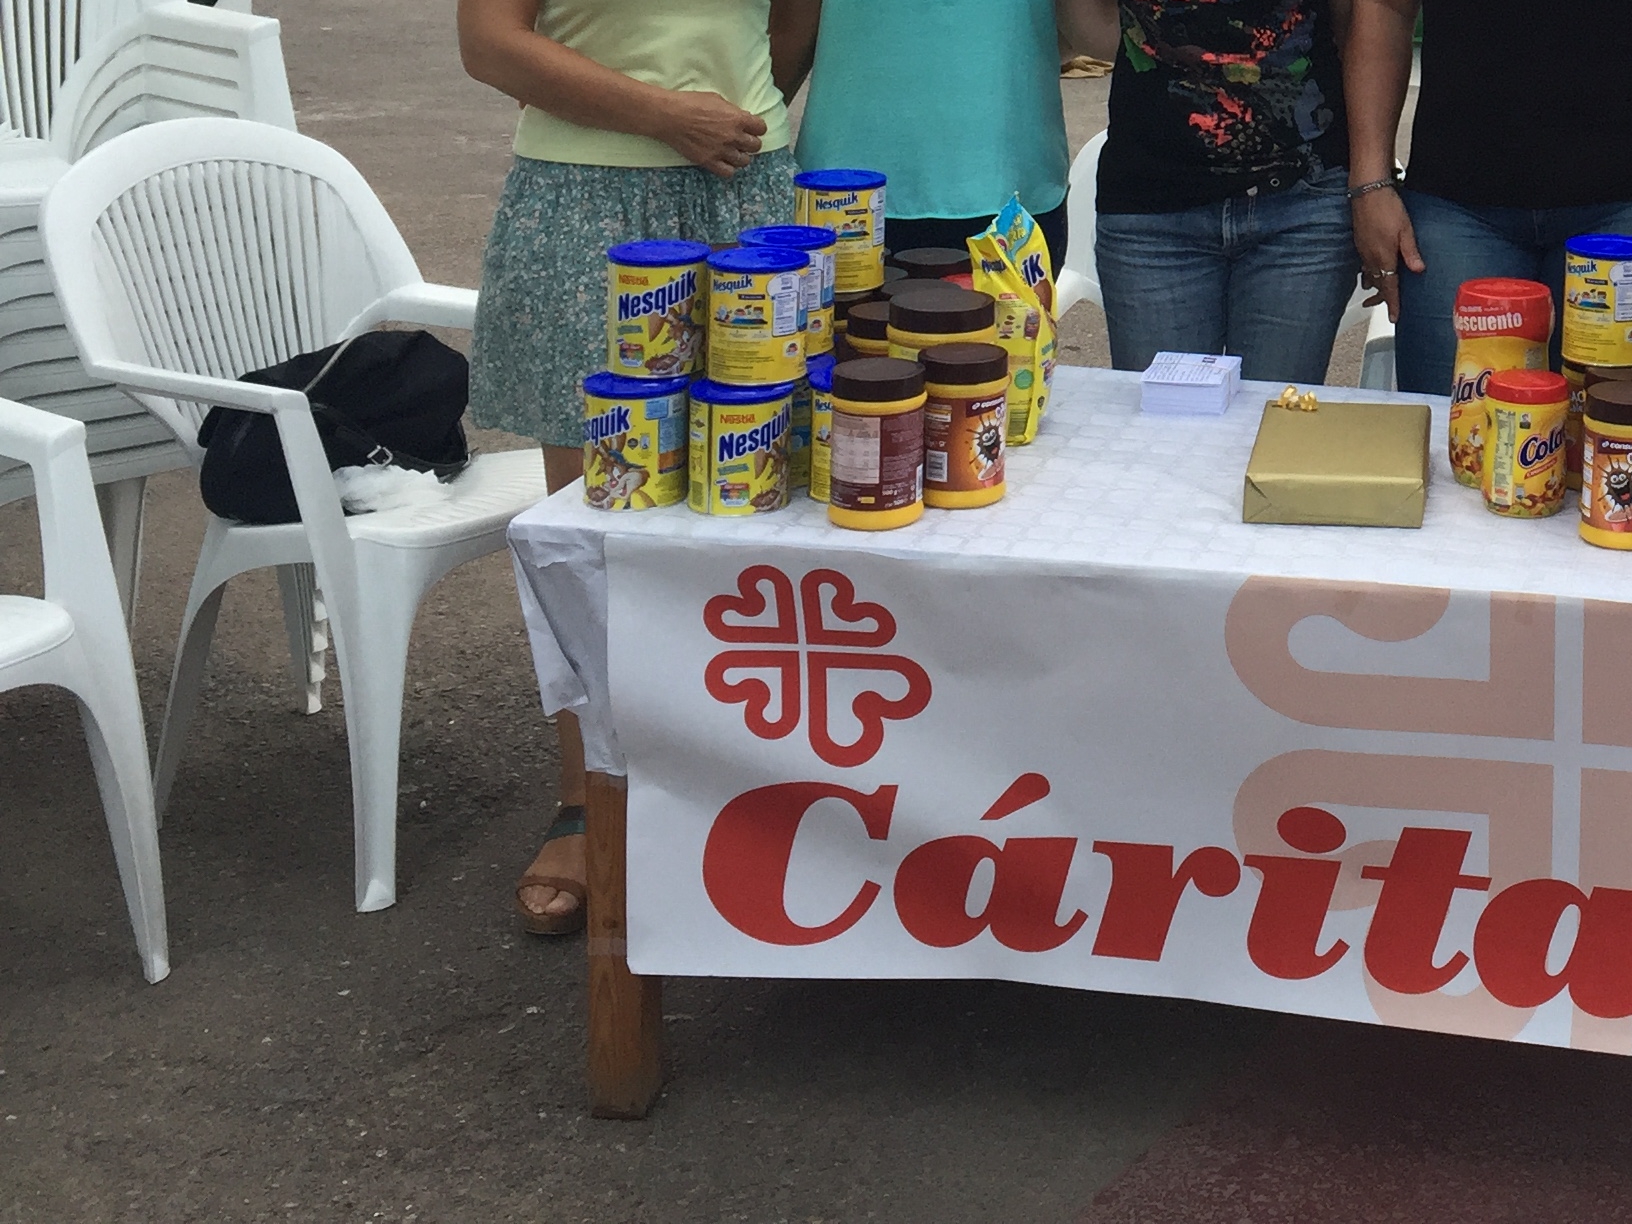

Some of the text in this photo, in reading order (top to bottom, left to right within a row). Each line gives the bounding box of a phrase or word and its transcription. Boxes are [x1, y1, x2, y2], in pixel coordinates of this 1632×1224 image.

[815, 192, 858, 212] Nesquik
[618, 269, 697, 322] Nesquik
[718, 402, 791, 463] Nesquik
